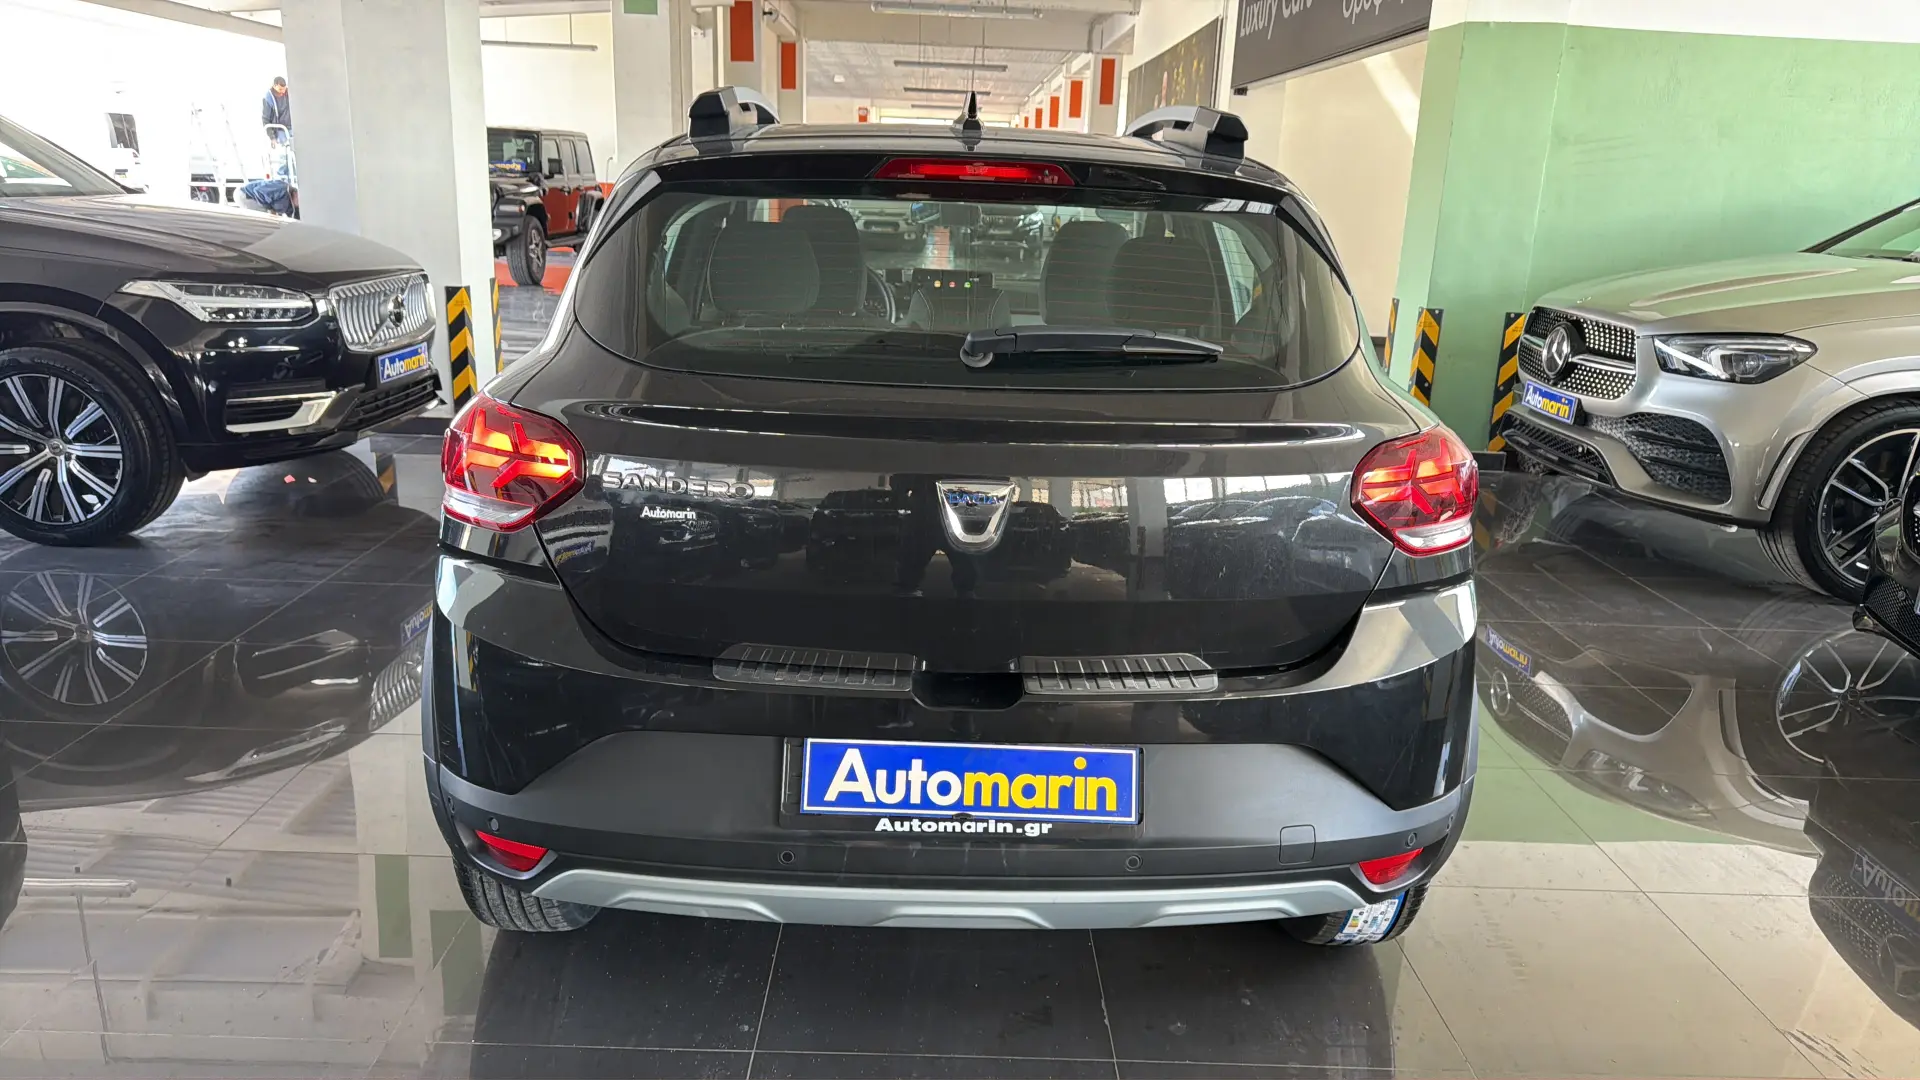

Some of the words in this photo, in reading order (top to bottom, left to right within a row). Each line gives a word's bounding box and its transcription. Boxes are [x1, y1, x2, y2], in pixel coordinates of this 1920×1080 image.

[1240, 0, 1278, 40] Luxury
[384, 348, 426, 379] Automarin
[1525, 384, 1570, 418] Automarin
[601, 471, 755, 499] SANDERO
[640, 505, 696, 520] Automarin
[823, 748, 1117, 811] Automarin
[875, 817, 1053, 837] Automarin.gr
